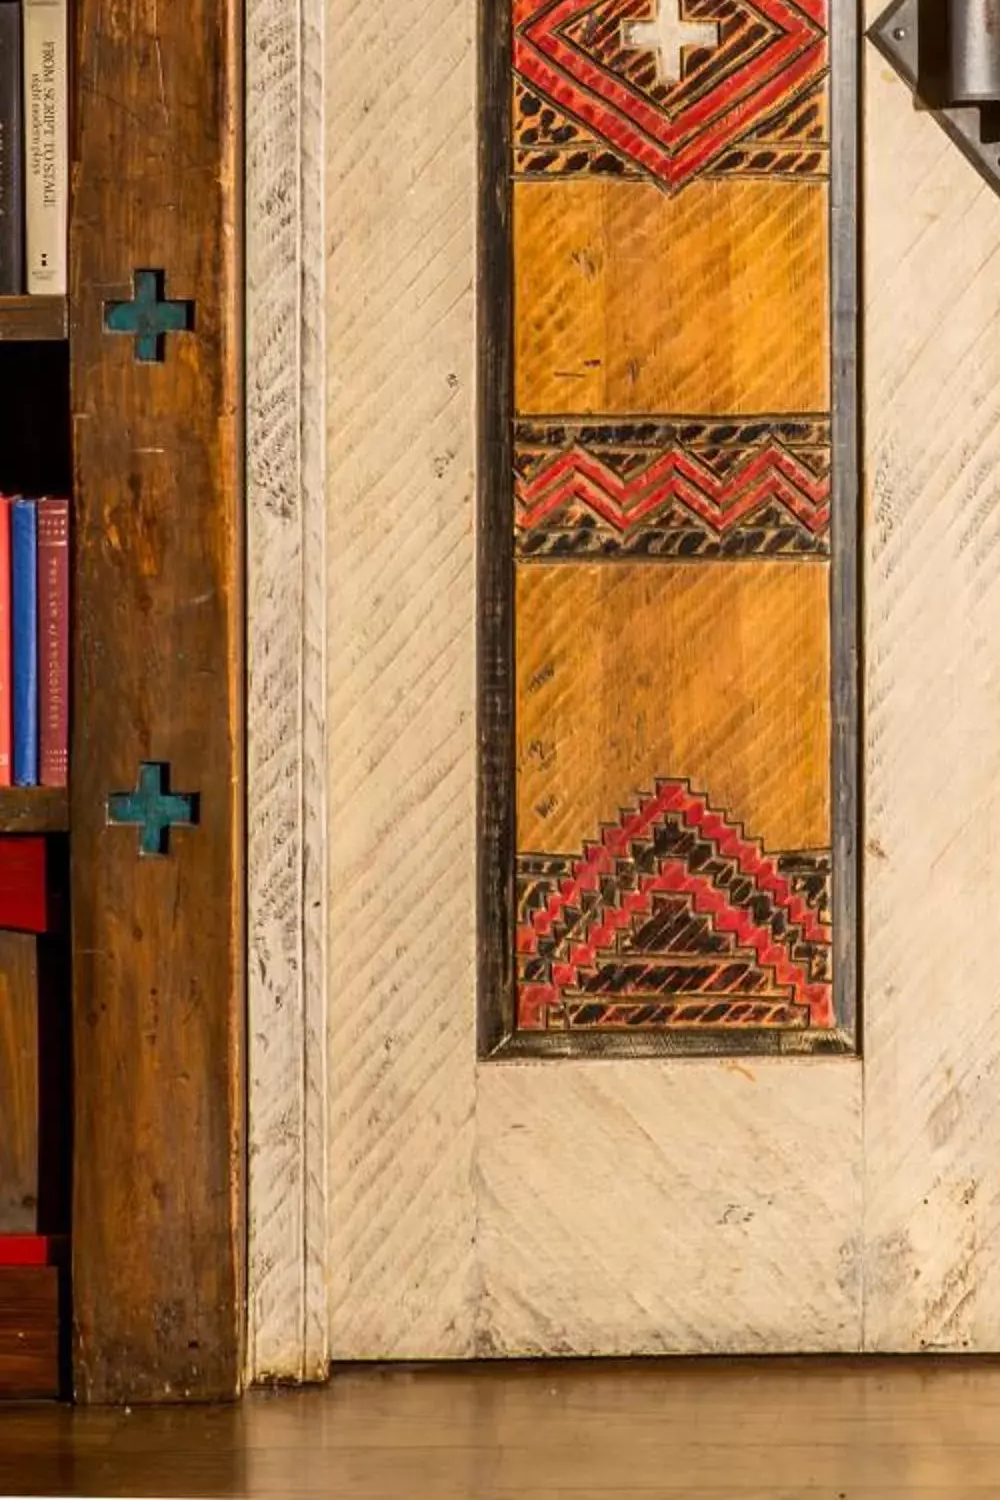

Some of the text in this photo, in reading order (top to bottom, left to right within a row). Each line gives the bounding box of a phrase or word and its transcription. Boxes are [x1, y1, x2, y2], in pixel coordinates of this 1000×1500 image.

[31, 73, 43, 175] eight modern plays
[42, 41, 57, 208] FROM SCRIPT TO STAGE
